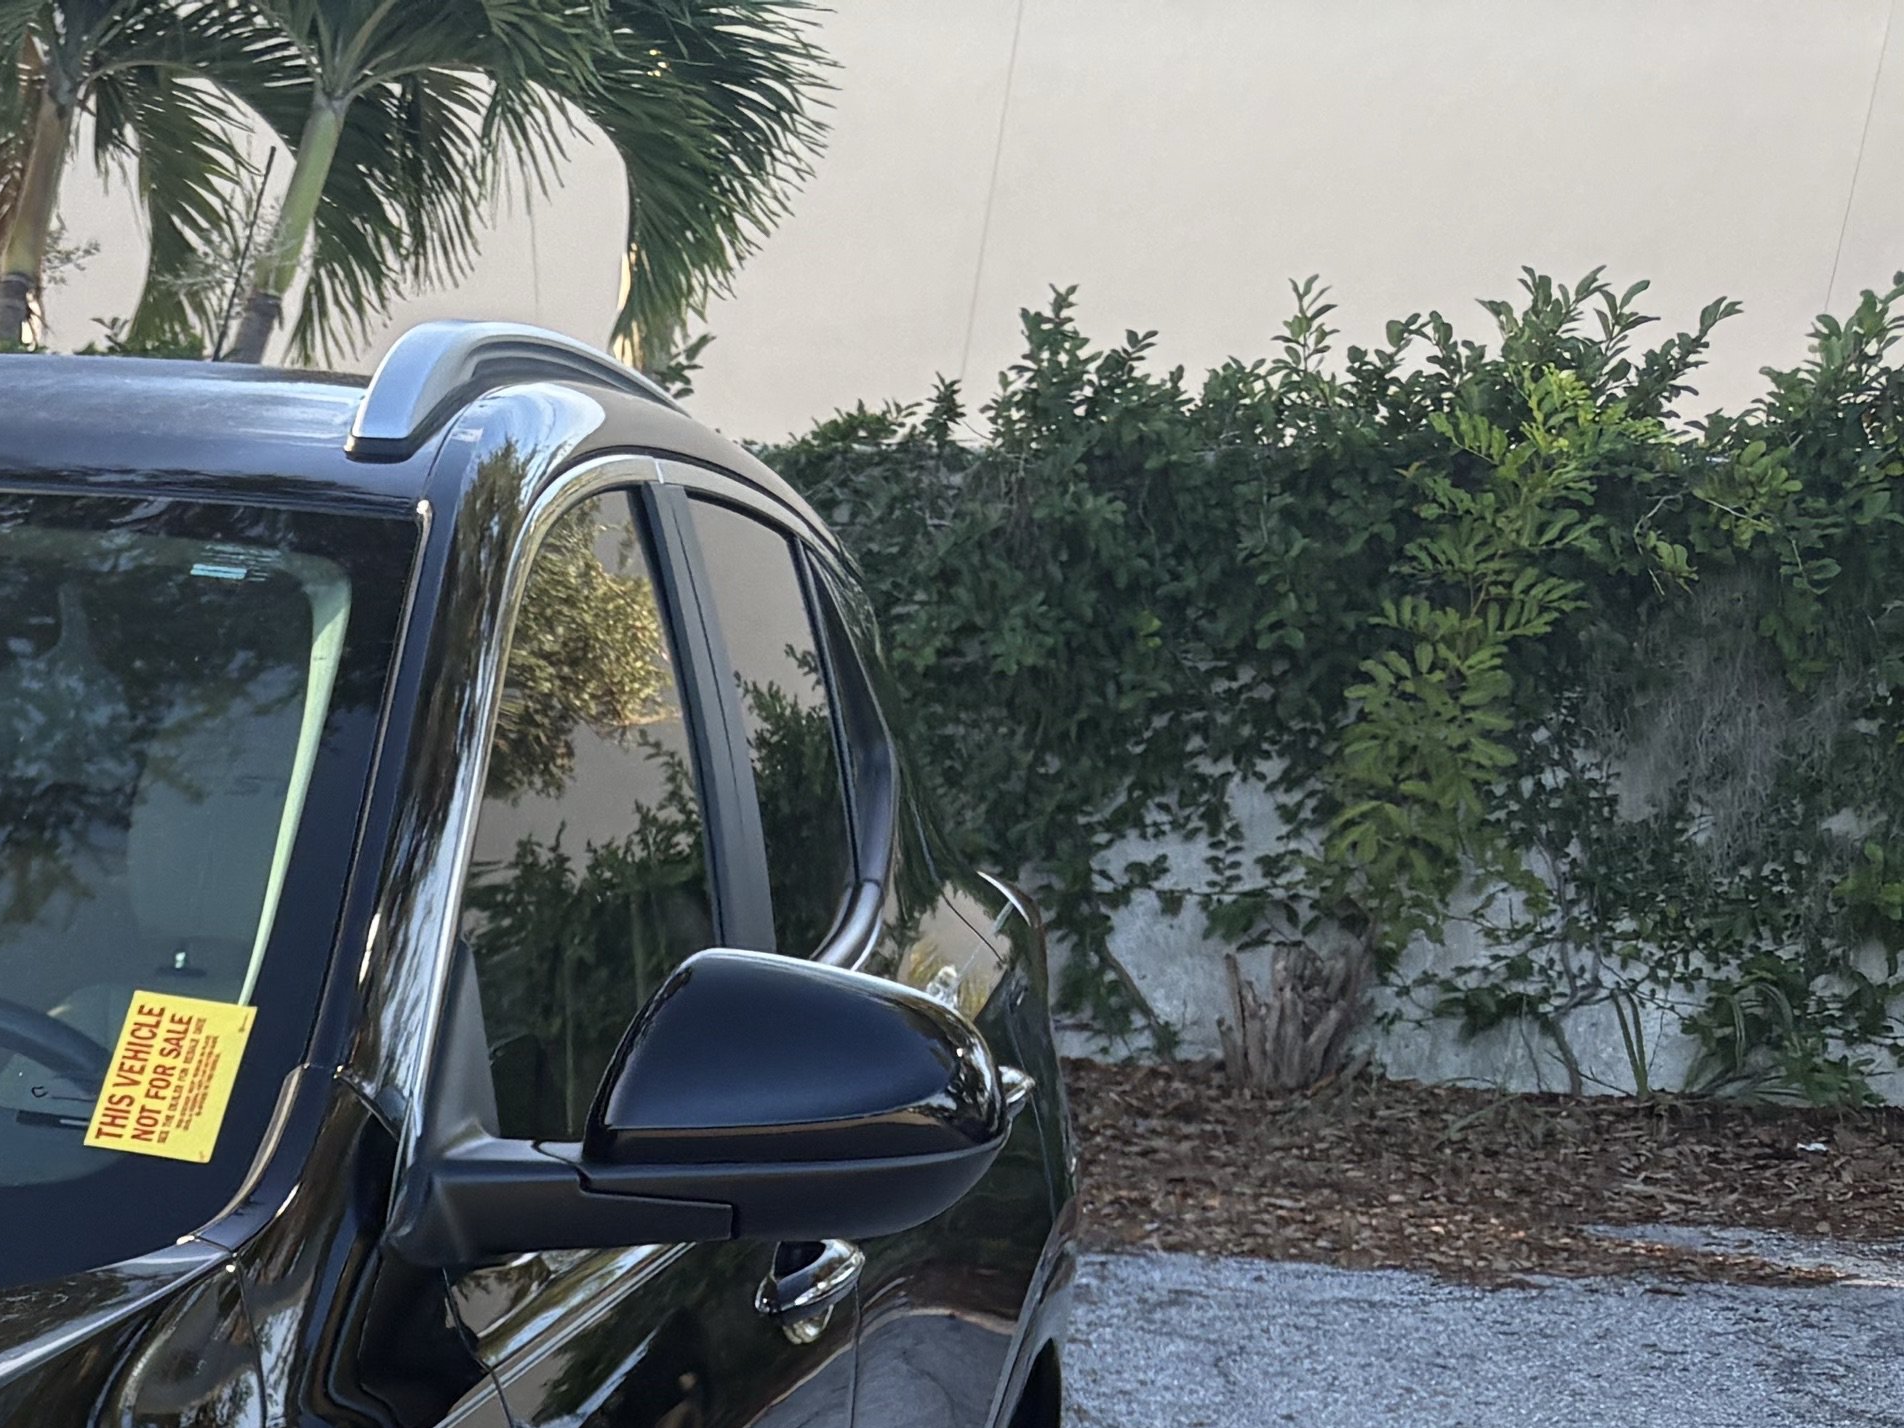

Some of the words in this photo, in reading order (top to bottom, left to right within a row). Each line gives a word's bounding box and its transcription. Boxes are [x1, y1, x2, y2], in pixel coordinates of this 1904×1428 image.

[113, 1005, 165, 1088] VEHICLE
[159, 1014, 192, 1059] SALE
[145, 1064, 176, 1099] FOR
[95, 1093, 135, 1140] THIS
[131, 1105, 162, 1141] NOT
